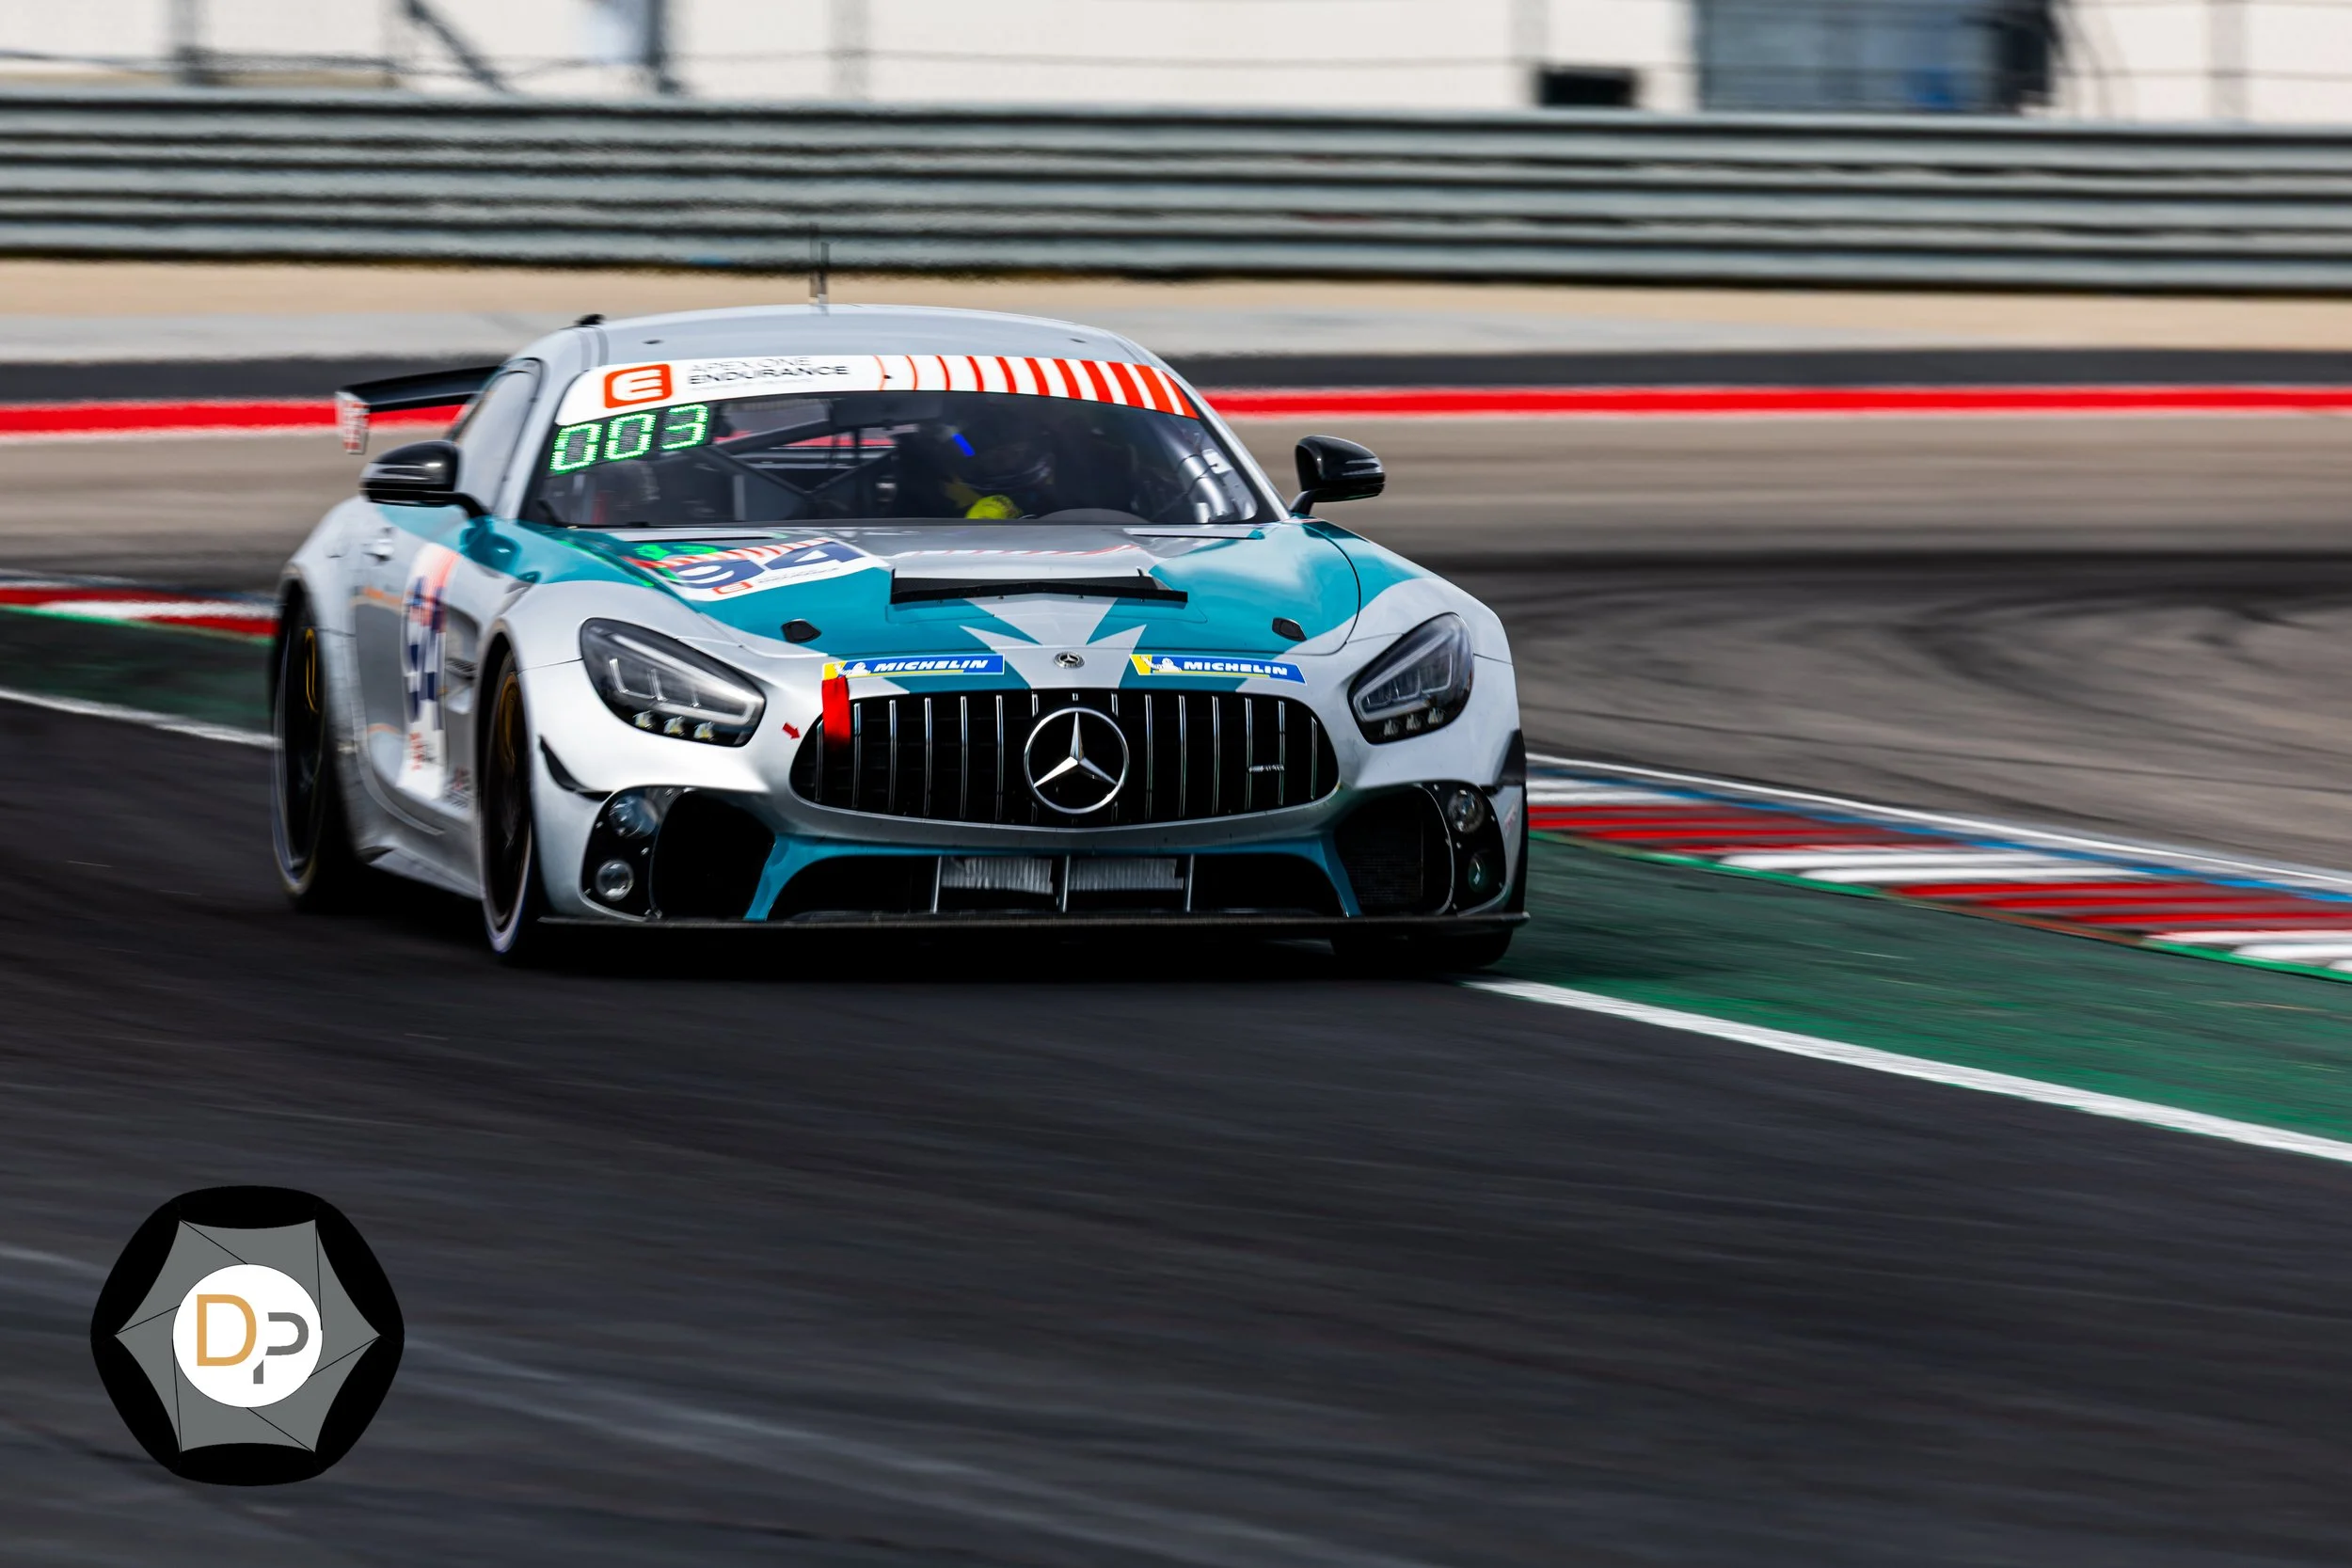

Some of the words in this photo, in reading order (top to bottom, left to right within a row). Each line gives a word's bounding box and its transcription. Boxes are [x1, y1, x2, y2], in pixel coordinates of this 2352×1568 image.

[689, 365, 850, 385] ENDURANCE
[549, 404, 708, 474] 003
[672, 541, 866, 590] 94
[873, 659, 989, 673] MICHELIN
[1184, 660, 1288, 675] MICHELIN
